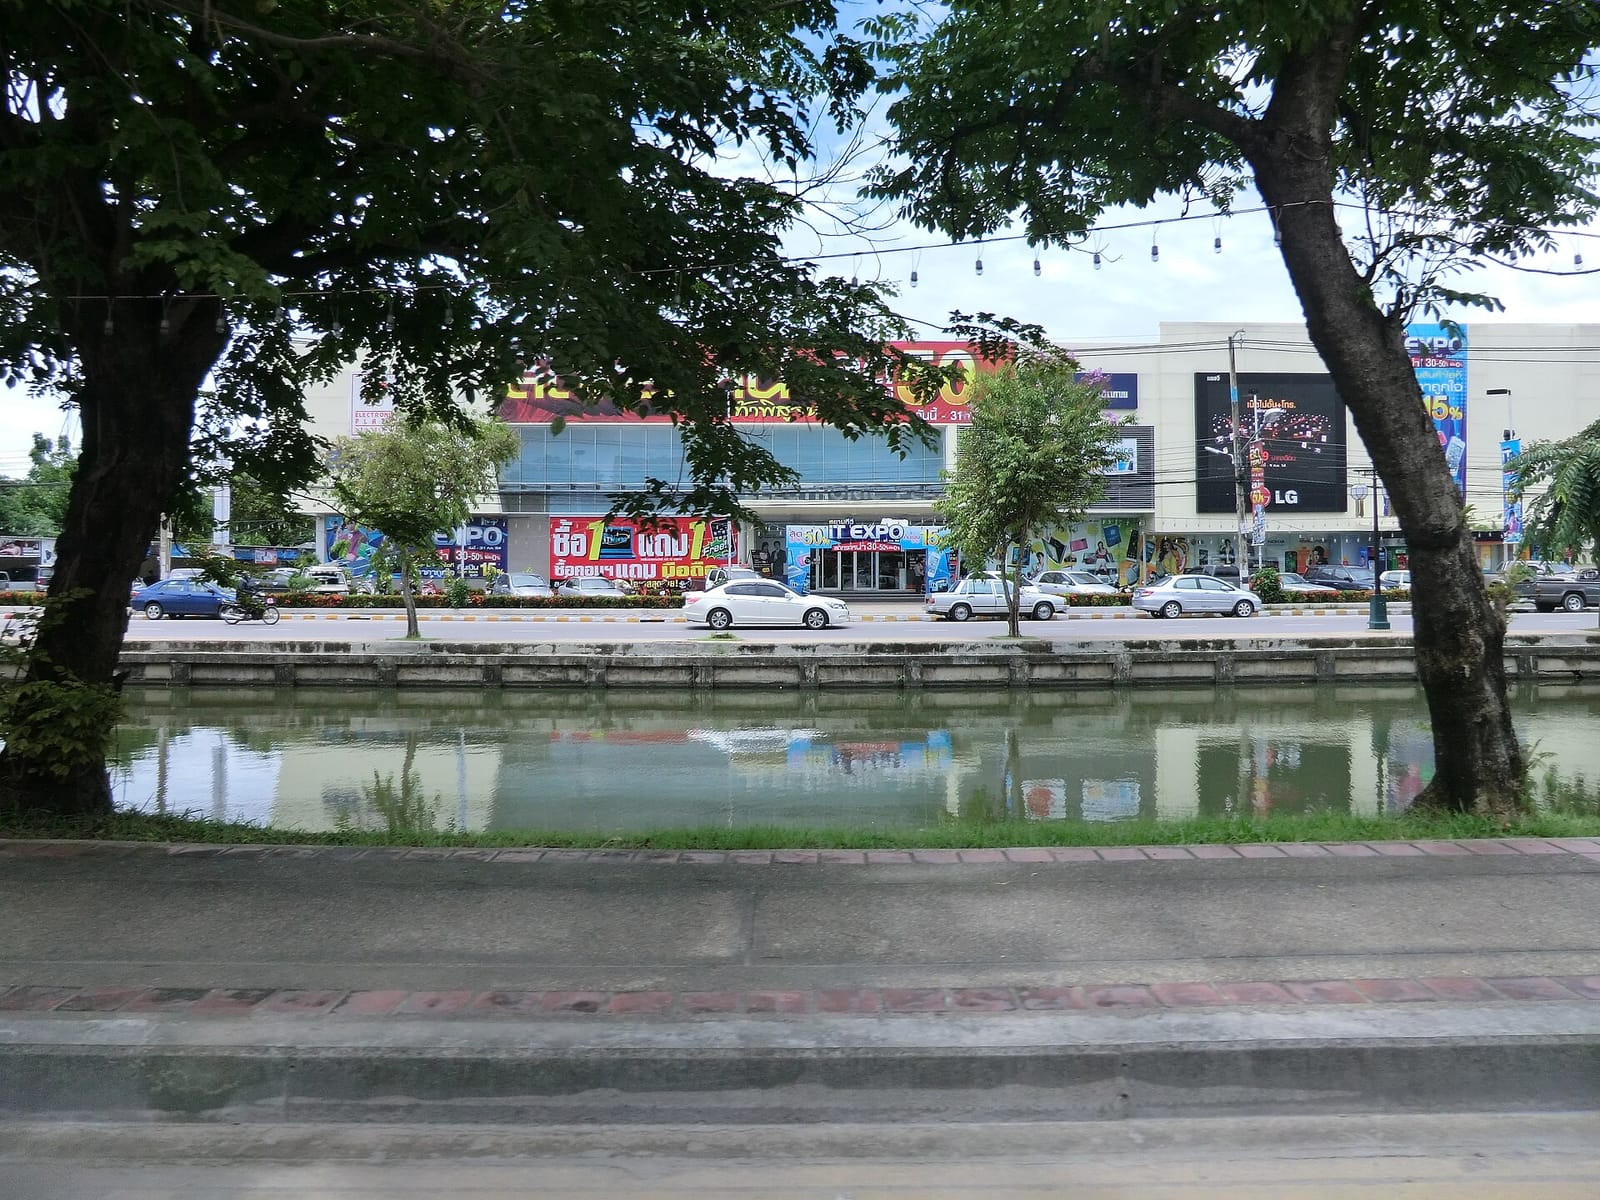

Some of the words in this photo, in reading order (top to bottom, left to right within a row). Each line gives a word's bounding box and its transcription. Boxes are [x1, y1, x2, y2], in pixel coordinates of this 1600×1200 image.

[1275, 490, 1298, 504] LG
[828, 525, 847, 539] IT
[850, 524, 904, 540] EXPO
[589, 521, 605, 560] 1
[689, 521, 706, 560] 1
